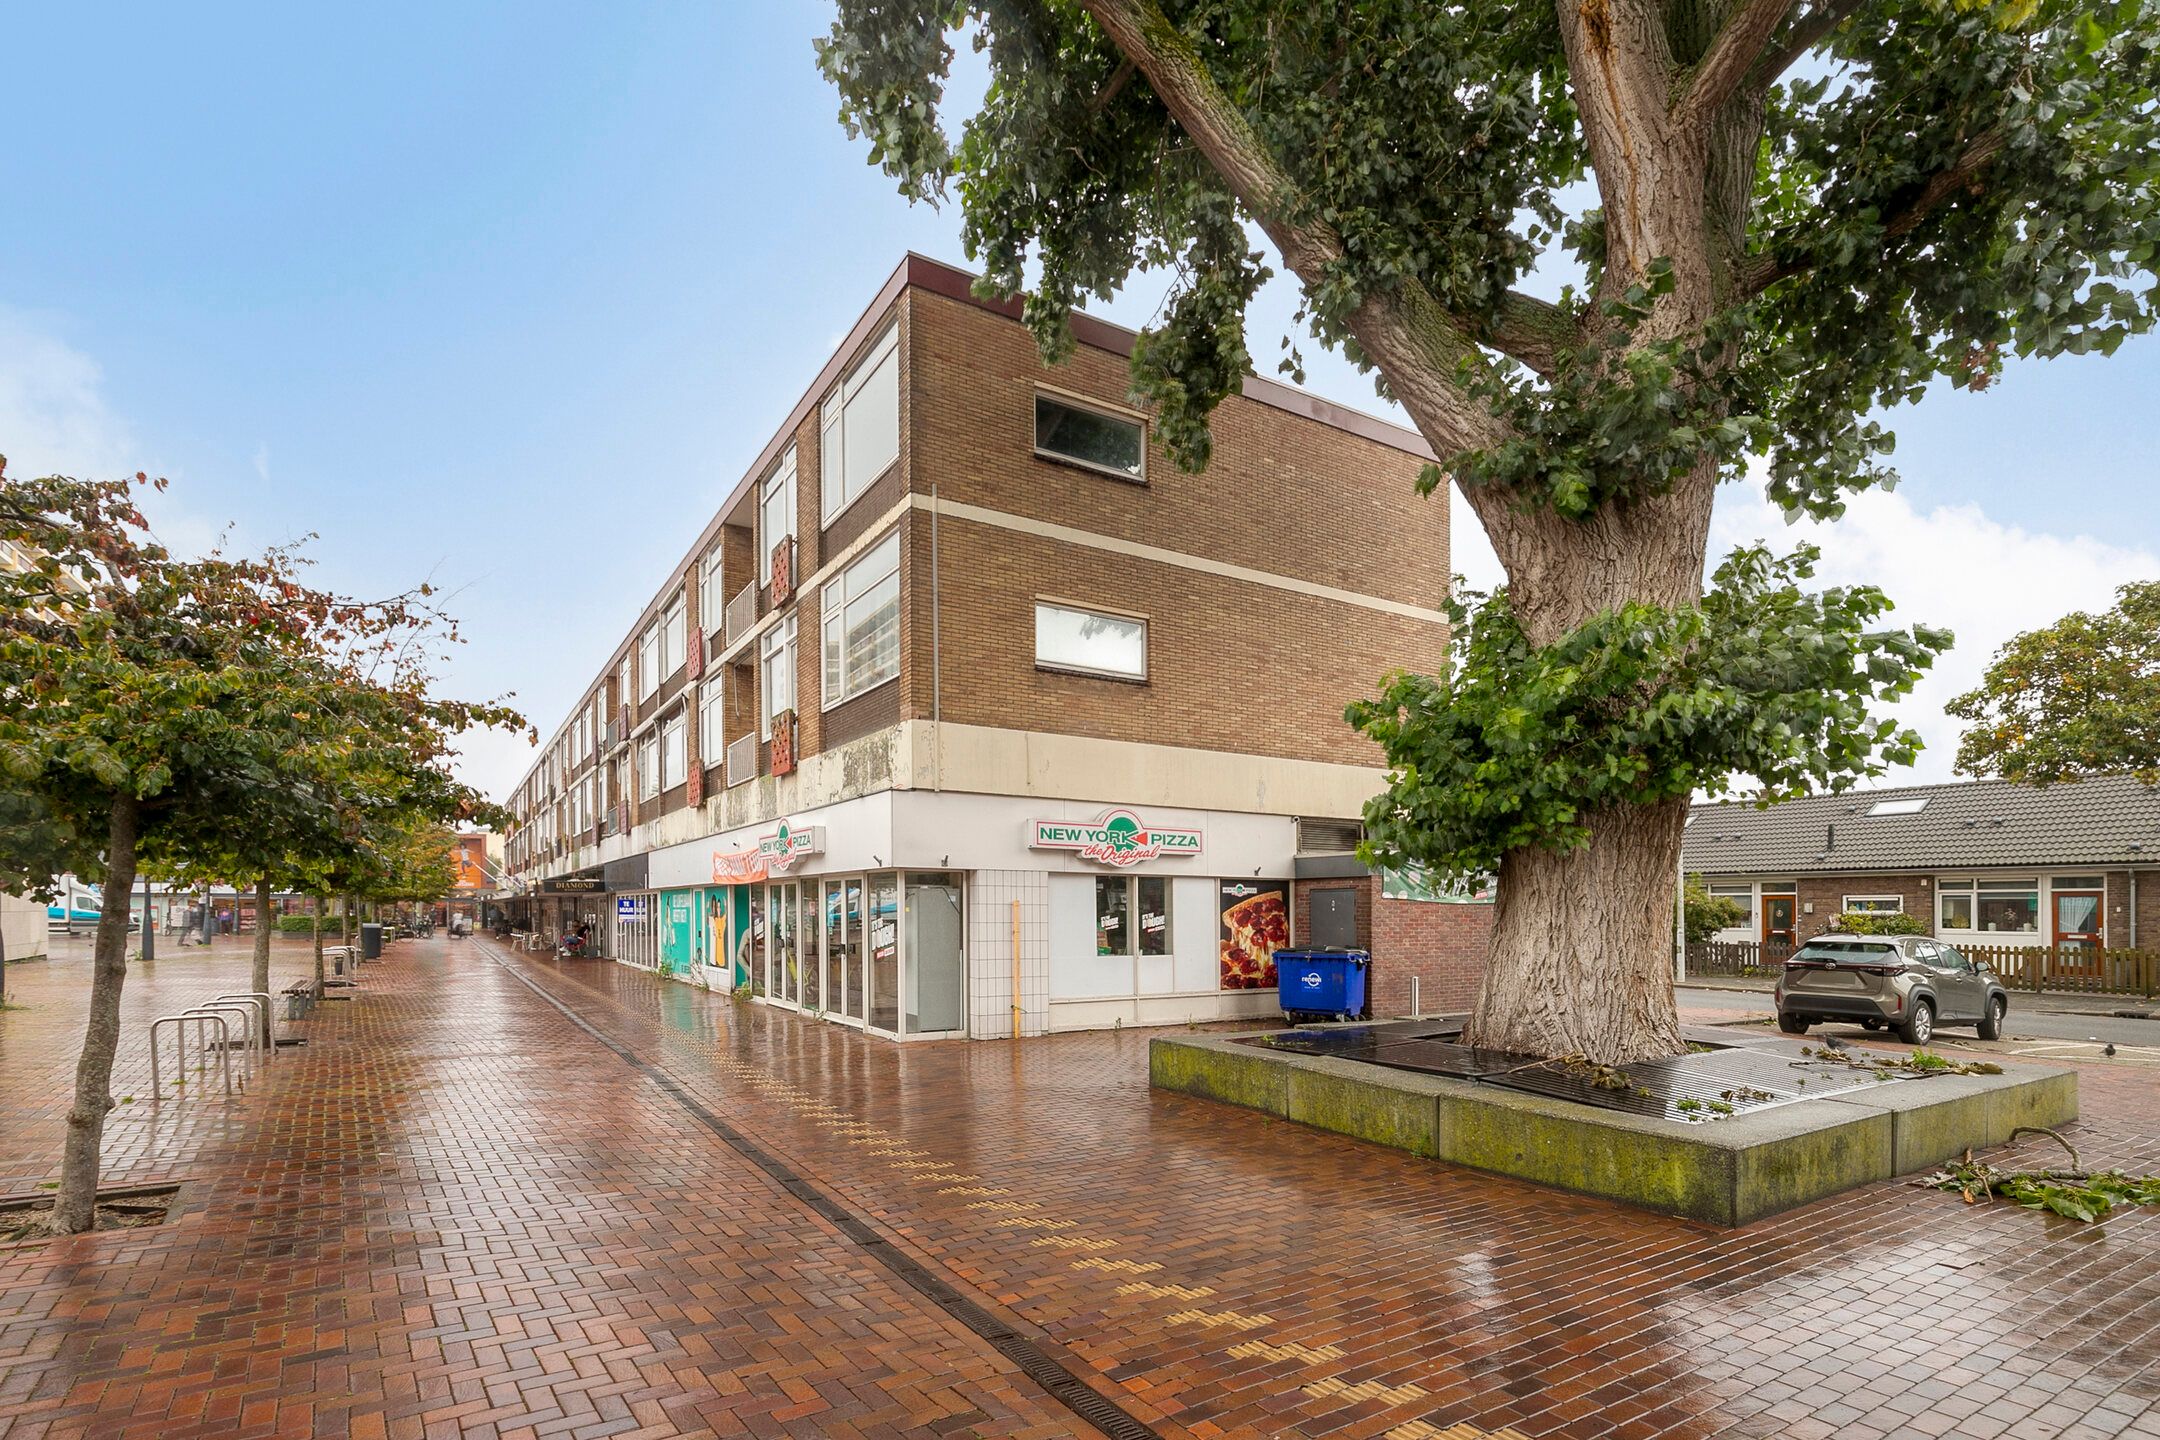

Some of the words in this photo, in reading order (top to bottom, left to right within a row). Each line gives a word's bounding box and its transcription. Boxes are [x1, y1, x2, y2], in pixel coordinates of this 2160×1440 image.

[760, 843, 772, 854] NEW
[793, 834, 811, 847] PIZZA
[1040, 827, 1081, 841] NEW
[1085, 829, 1138, 846] YORK
[1151, 834, 1199, 847] PIZZA
[1084, 844, 1102, 856] the
[1100, 844, 1160, 865] Original
